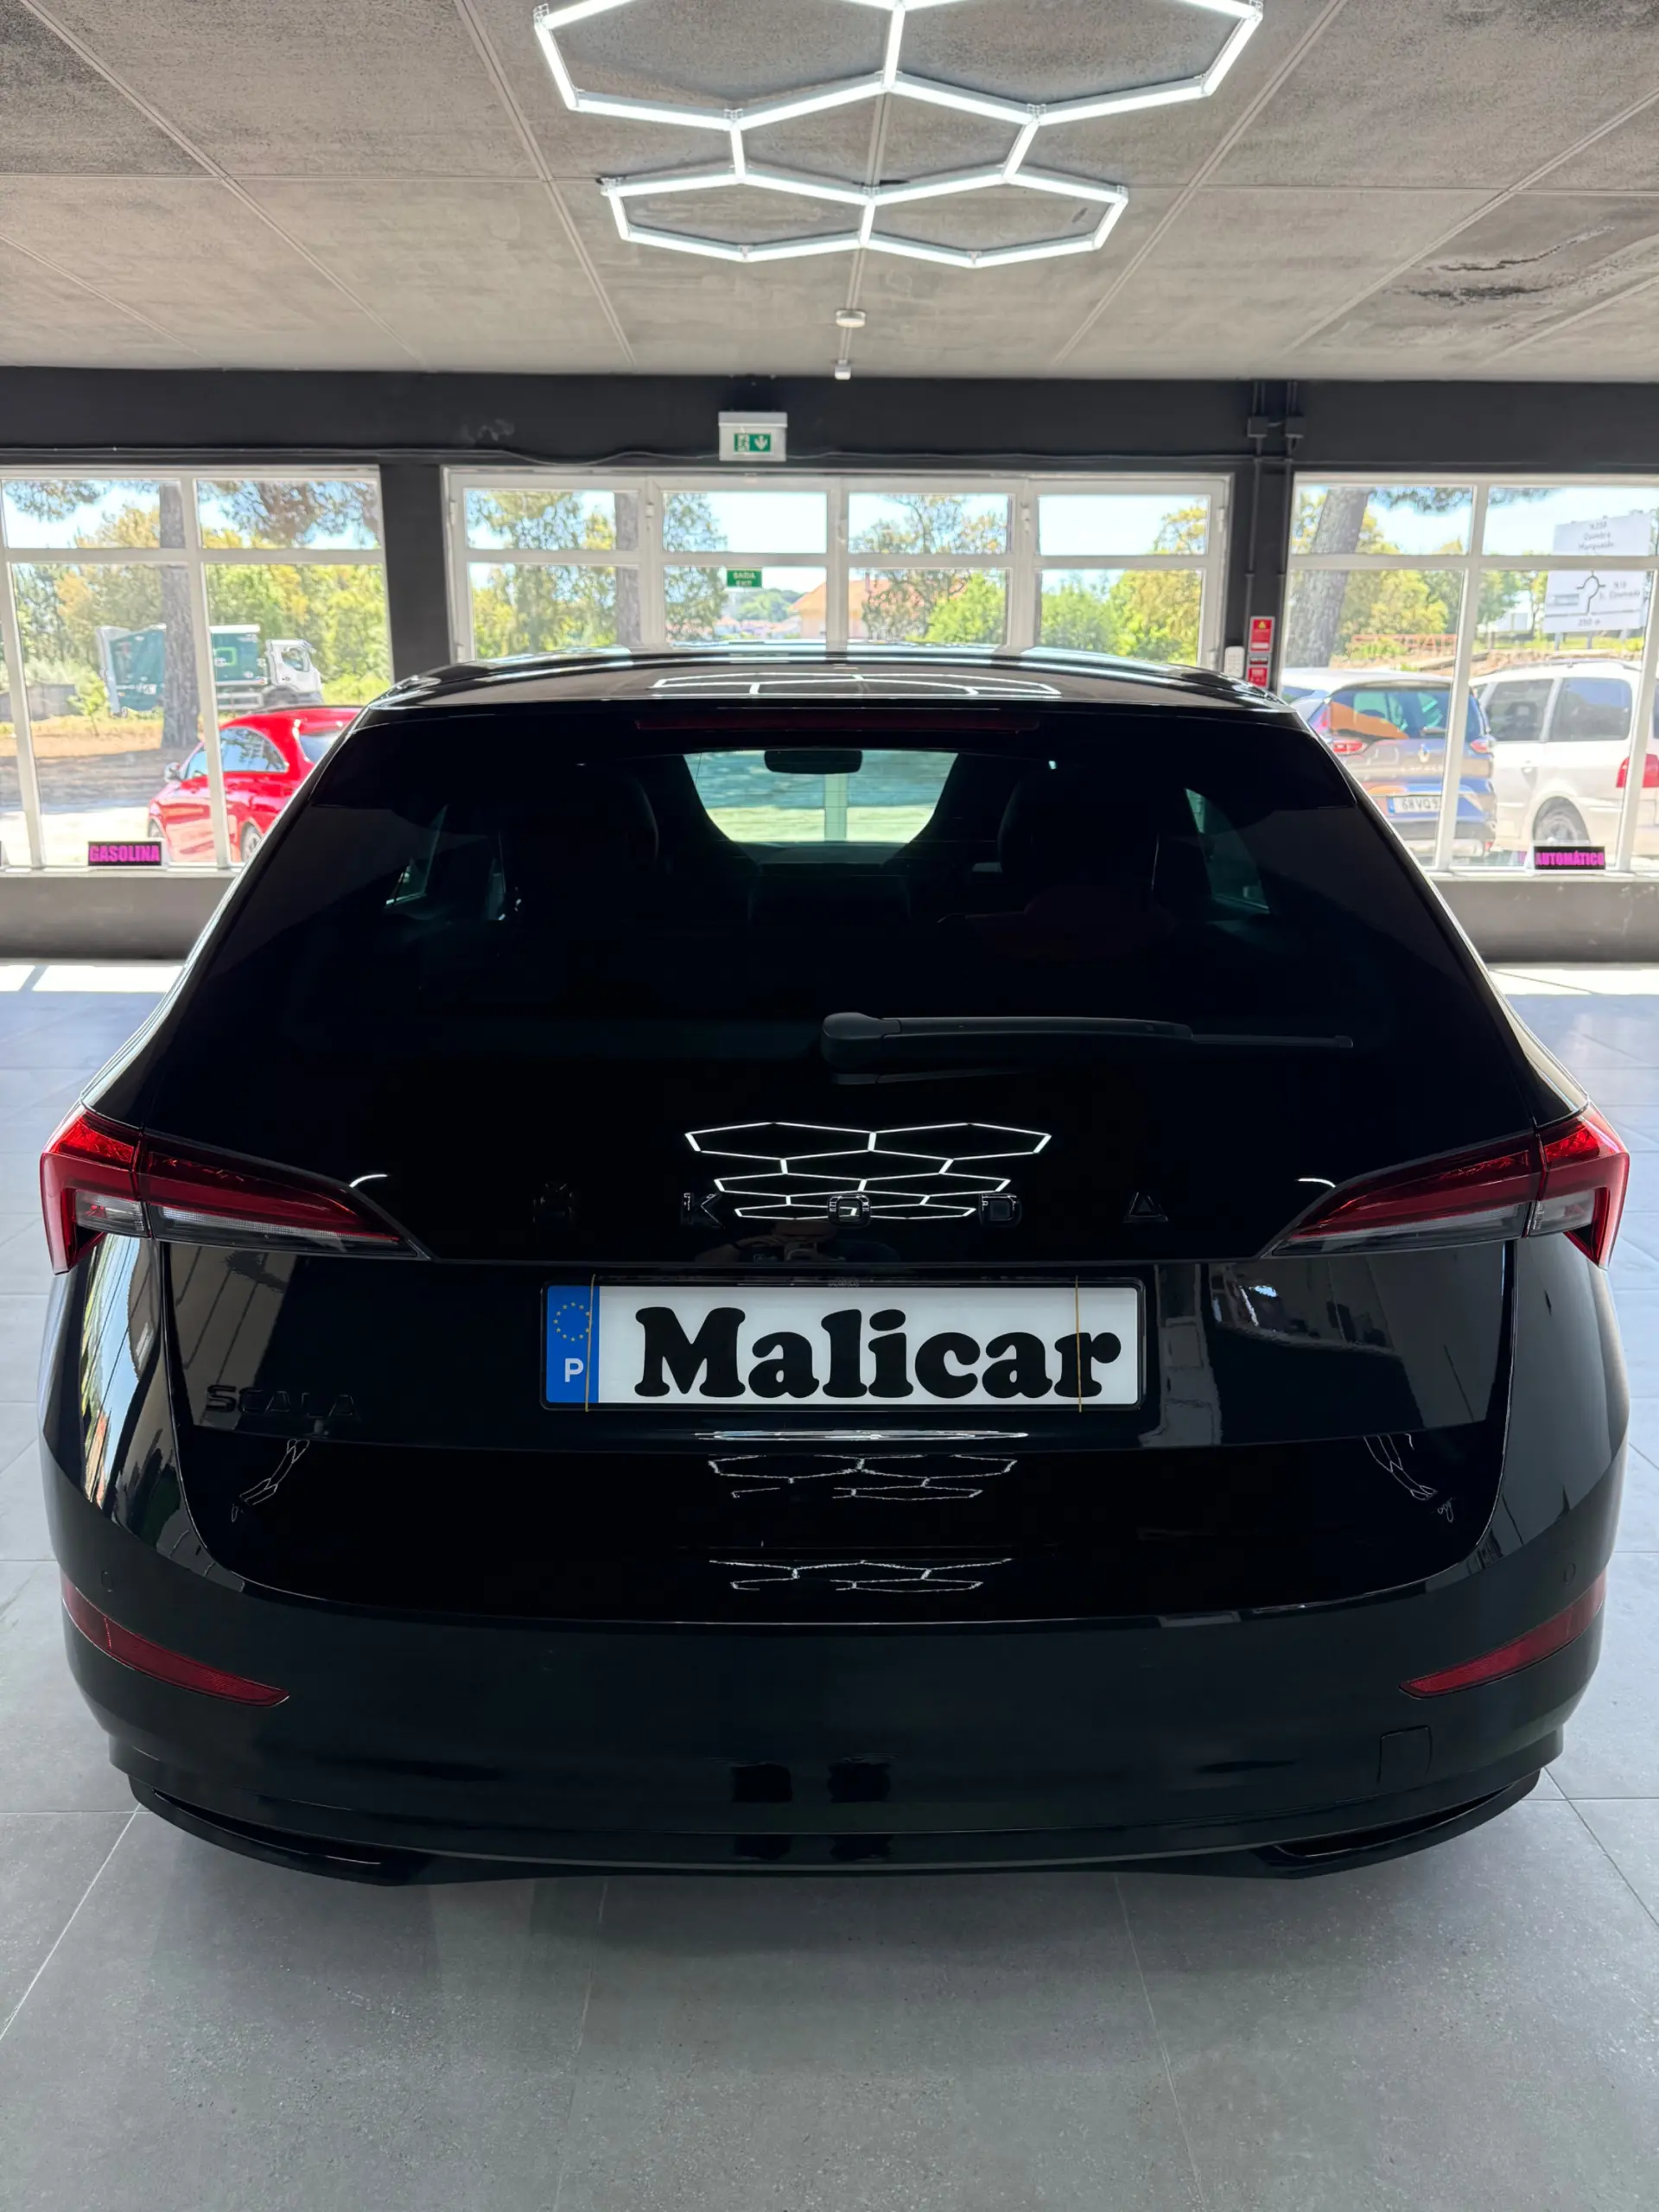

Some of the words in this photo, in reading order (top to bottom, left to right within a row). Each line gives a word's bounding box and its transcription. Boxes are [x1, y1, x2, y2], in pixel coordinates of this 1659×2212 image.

[89, 844, 160, 862] GASOLINA
[1535, 850, 1605, 866] AUTOMÁTICO
[635, 1306, 1122, 1398] Malicar
[564, 1357, 584, 1382] P
[205, 1384, 362, 1423] SCALA
